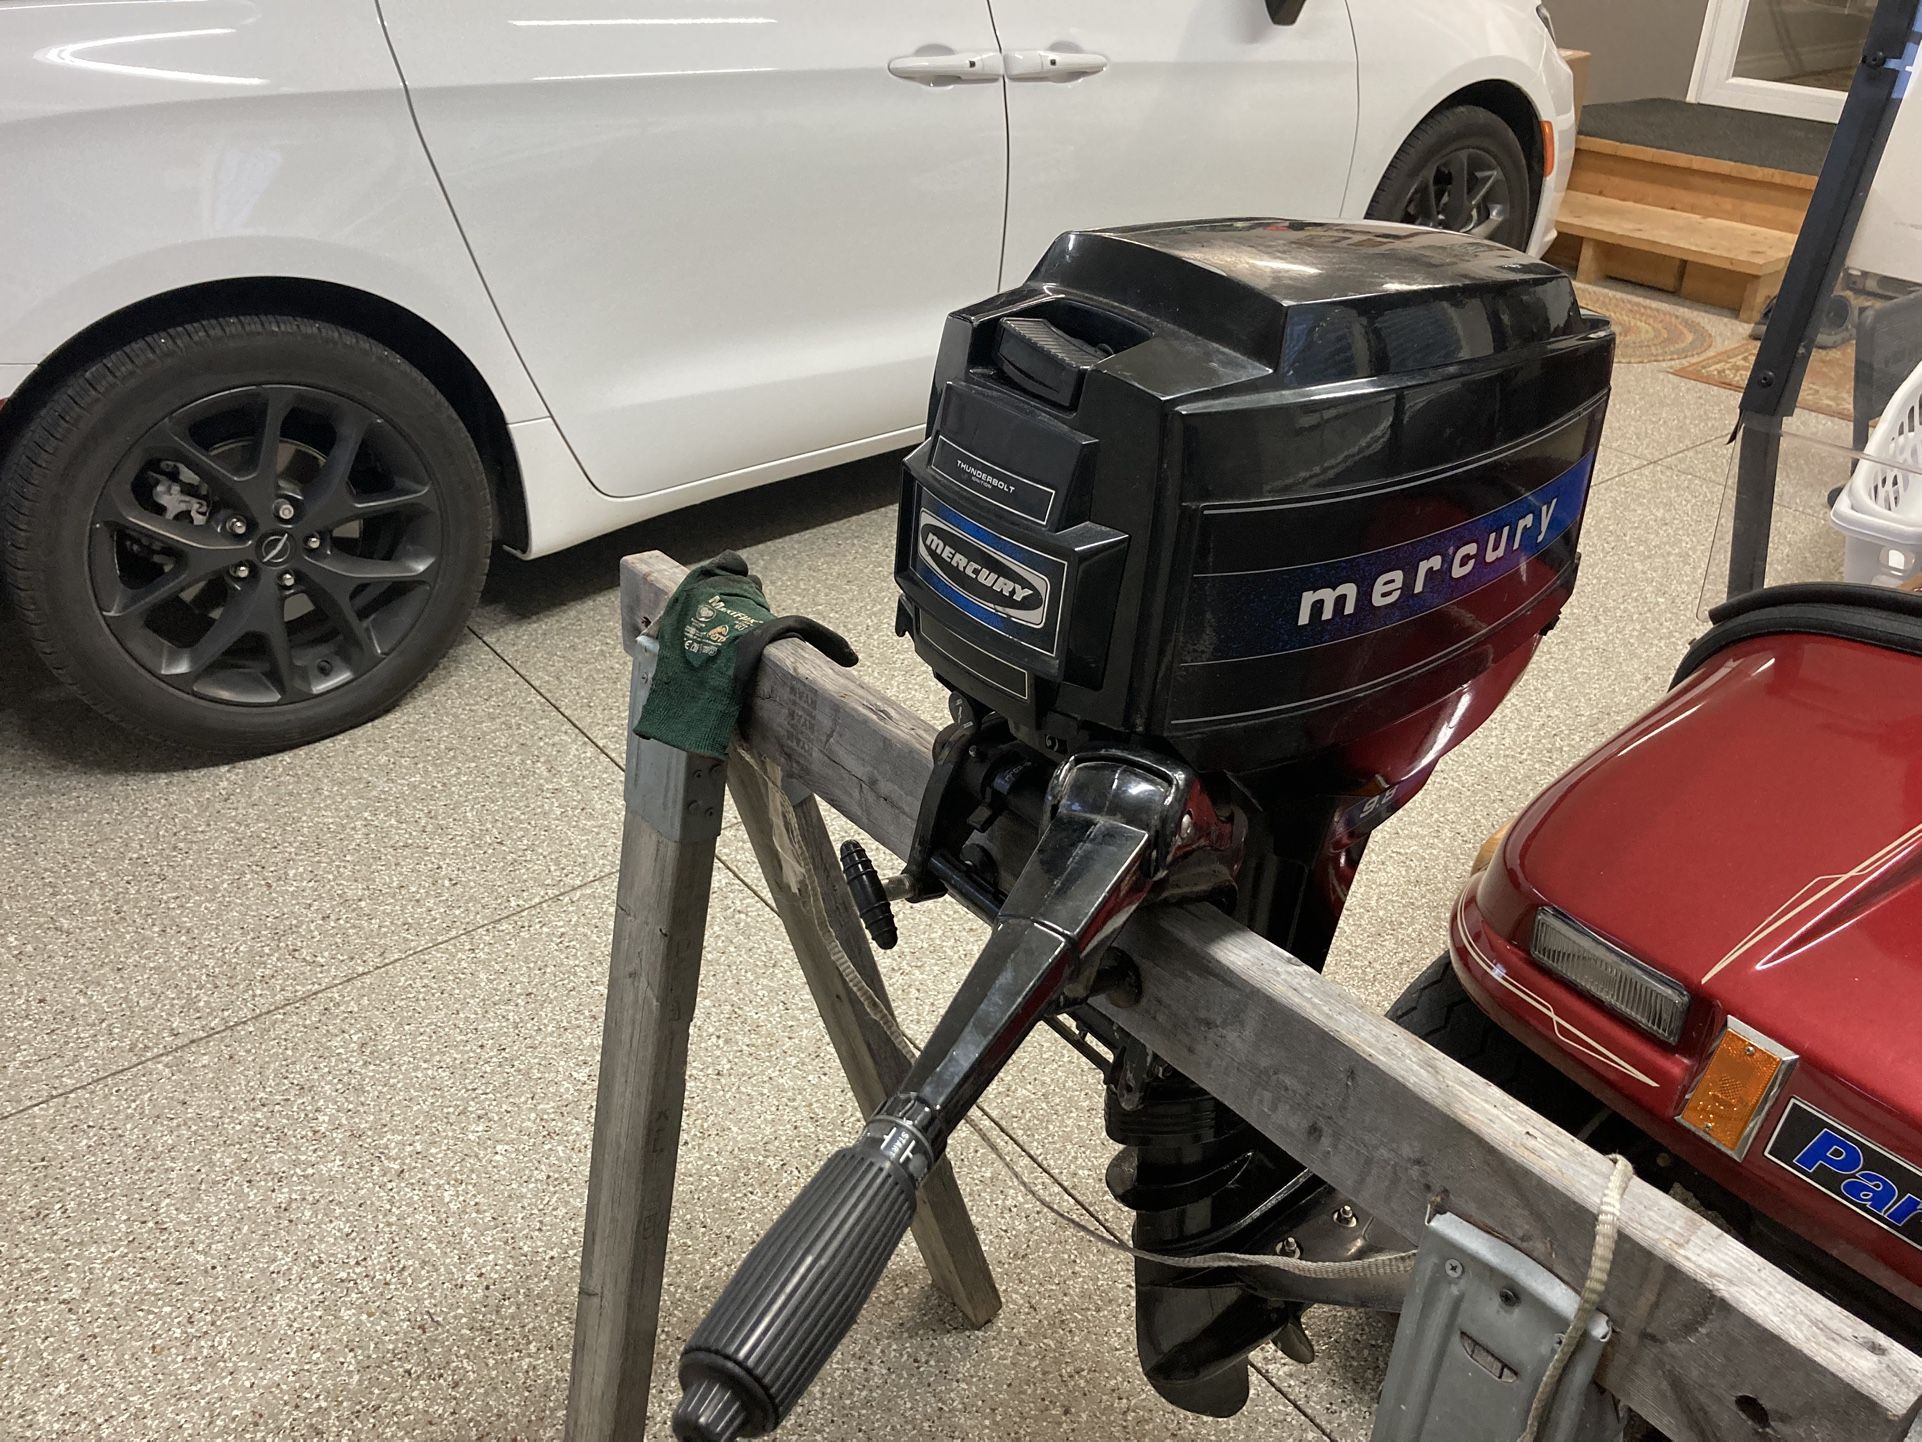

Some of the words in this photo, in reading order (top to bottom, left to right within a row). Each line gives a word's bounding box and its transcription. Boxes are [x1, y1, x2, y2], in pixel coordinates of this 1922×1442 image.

[957, 460, 1015, 493] THUNDERBOLT
[925, 532, 1033, 602] MERCURY
[1298, 499, 1557, 625] mercury
